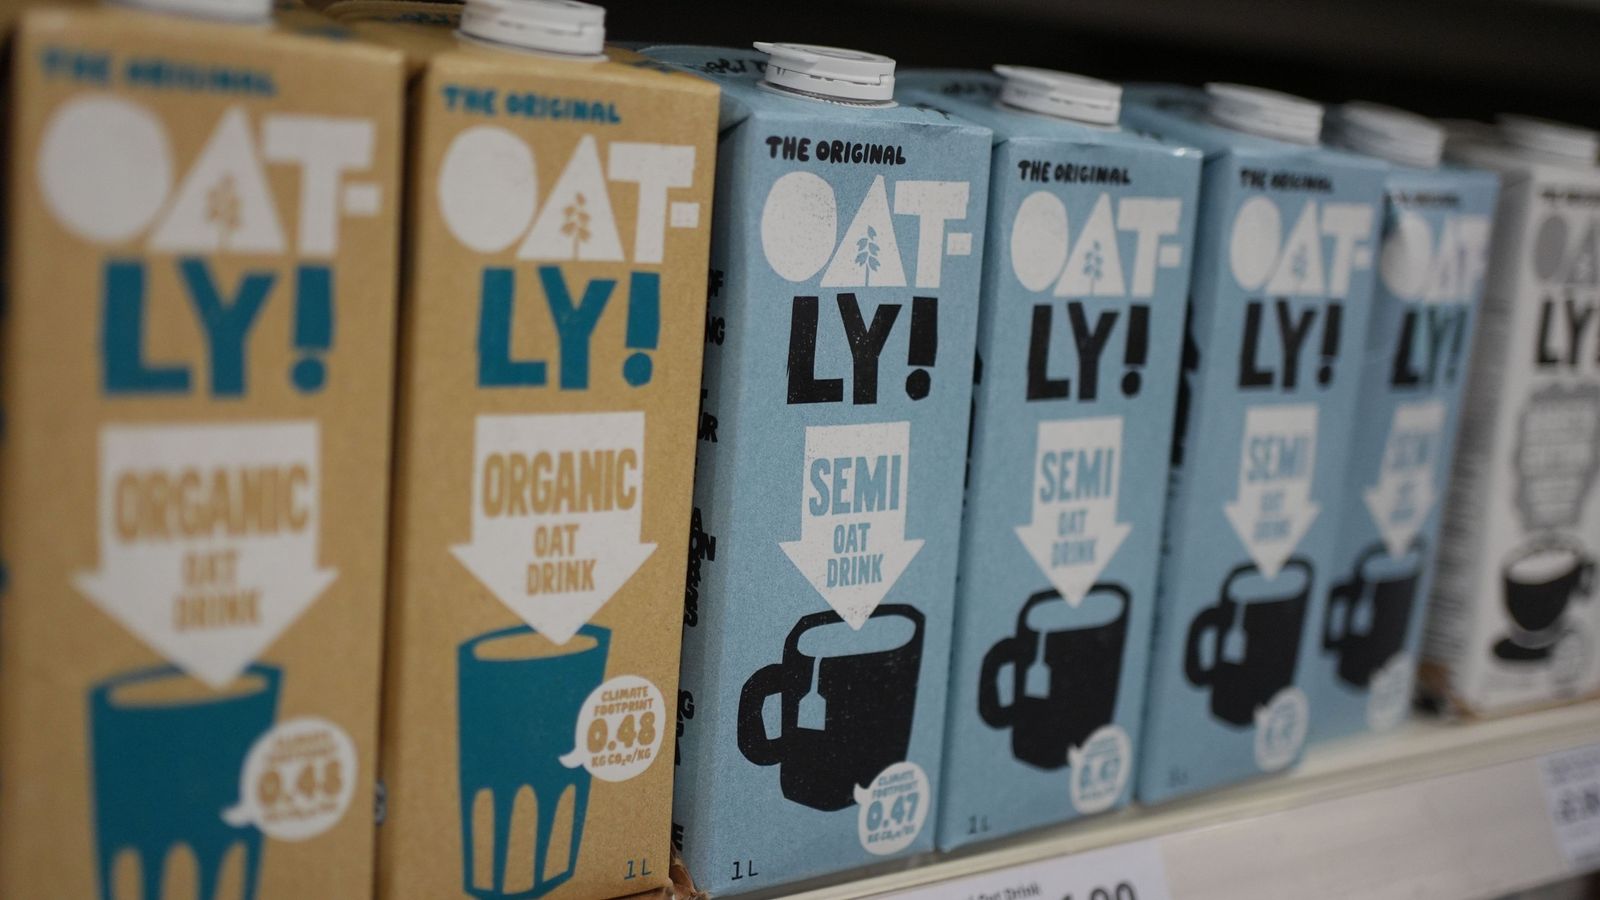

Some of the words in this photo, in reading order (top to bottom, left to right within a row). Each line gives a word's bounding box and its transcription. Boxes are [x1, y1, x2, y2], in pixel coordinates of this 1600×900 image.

[442, 85, 497, 116] THE
[506, 93, 621, 125] ORIGINAL
[37, 93, 382, 257] OAT-
[765, 136, 811, 161] THE
[816, 140, 906, 165] ORIGINAL
[1018, 160, 1049, 183] THE
[1054, 162, 1131, 185] ORIGINAL
[438, 125, 699, 264] OAT-
[760, 171, 973, 288] OAT-
[1010, 190, 1183, 298] OAT-
[101, 256, 337, 398] LY!
[475, 265, 661, 391] LY!
[786, 293, 938, 405] LY!
[1025, 301, 1151, 403] LY!
[1238, 297, 1343, 392] LY!
[113, 463, 311, 545] ORGANIC
[482, 447, 638, 519] ORGANIC
[809, 455, 902, 517] SEMI
[1039, 448, 1114, 504] SEMI
[534, 523, 580, 558] OAT
[833, 522, 871, 554] OAT
[526, 559, 597, 596] DRINK
[826, 553, 884, 588] DRINK
[594, 698, 654, 717] FOOTPRINT
[601, 686, 649, 702] CLIMATE
[587, 712, 656, 753] 0.48
[591, 755, 607, 768] KG
[866, 792, 920, 832] 0.47
